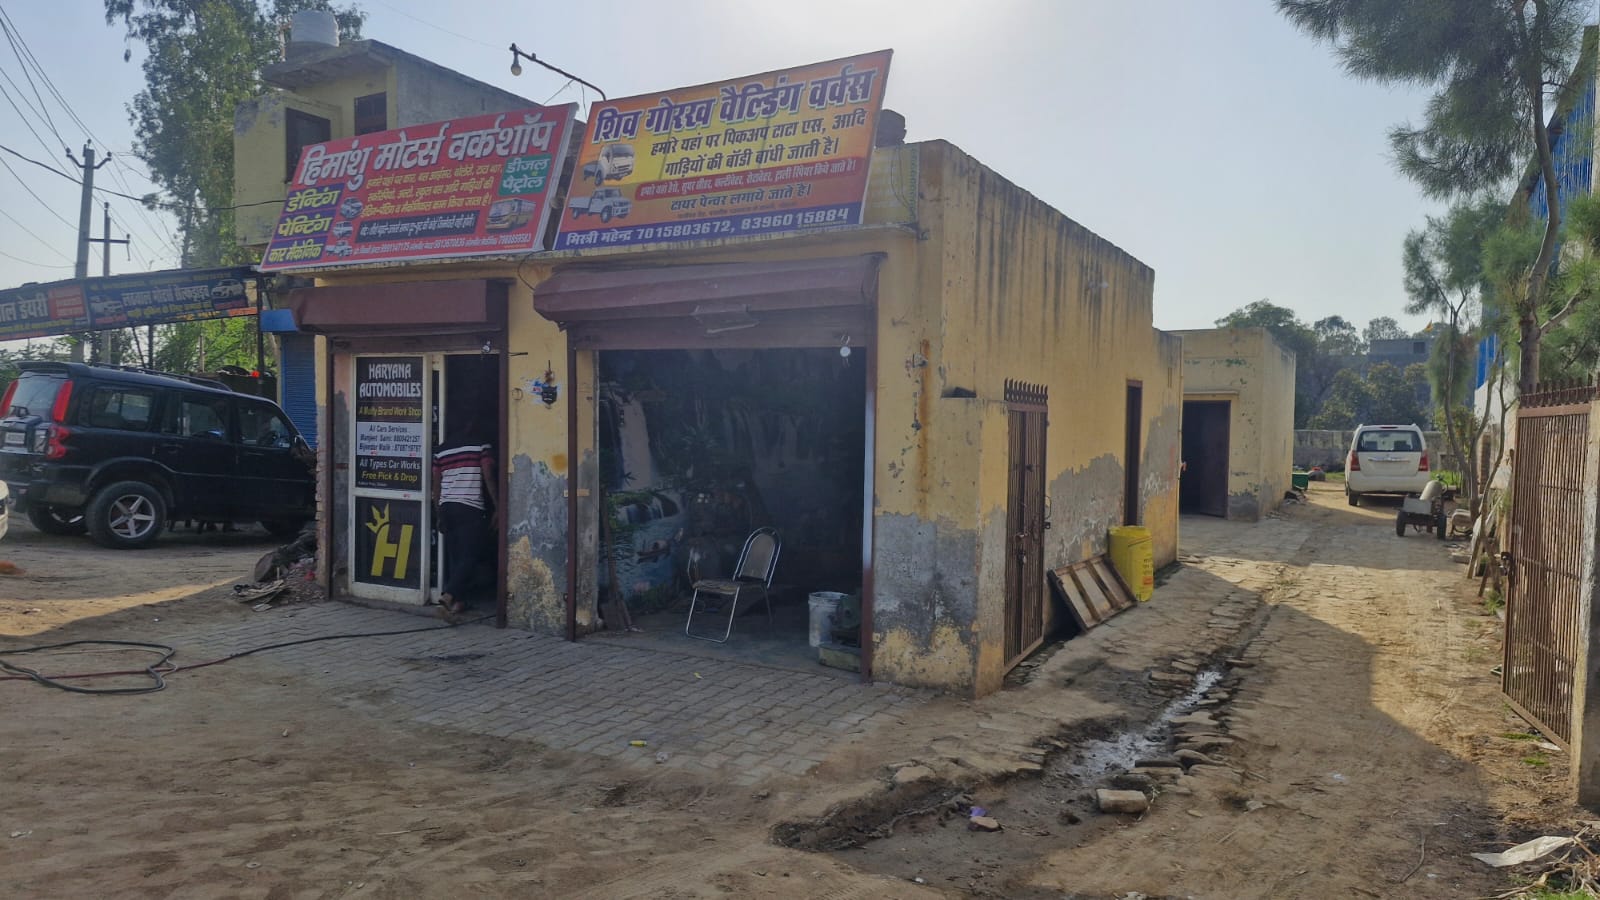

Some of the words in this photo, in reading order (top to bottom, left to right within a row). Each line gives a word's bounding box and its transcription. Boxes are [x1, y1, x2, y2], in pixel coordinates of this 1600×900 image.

[593, 107, 643, 144] शिव
[645, 97, 717, 135] गोरख
[720, 76, 805, 123] वैल्डिंग
[651, 137, 679, 156] हमारे
[681, 132, 703, 151] यहां
[705, 134, 721, 148] पर
[723, 126, 770, 146] पिकअप
[772, 122, 799, 138] टाटा
[801, 118, 826, 135] एस,
[832, 108, 867, 129] आदि
[298, 139, 373, 191] हिमांशु
[373, 123, 449, 171] मोटर्स
[449, 112, 557, 160] वर्कशॉप
[665, 153, 707, 177] गाड़ियों
[707, 152, 723, 170] की
[726, 148, 752, 168] बॉडी
[756, 144, 785, 164] बांधी
[787, 139, 821, 159] जाती
[505, 157, 551, 173] डीजल
[671, 198, 698, 211] टायर
[768, 184, 793, 200] जाते
[741, 207, 849, 230] 8396015884
[268, 247, 289, 262] कार
[369, 363, 411, 380] HARYANA
[359, 382, 421, 398] AUTOMOBILES
[370, 458, 387, 470] Types
[389, 460, 399, 469] Car
[401, 460, 420, 470] Works
[362, 470, 377, 480] Free
[378, 471, 392, 480] Pick
[401, 473, 418, 483] Drop
